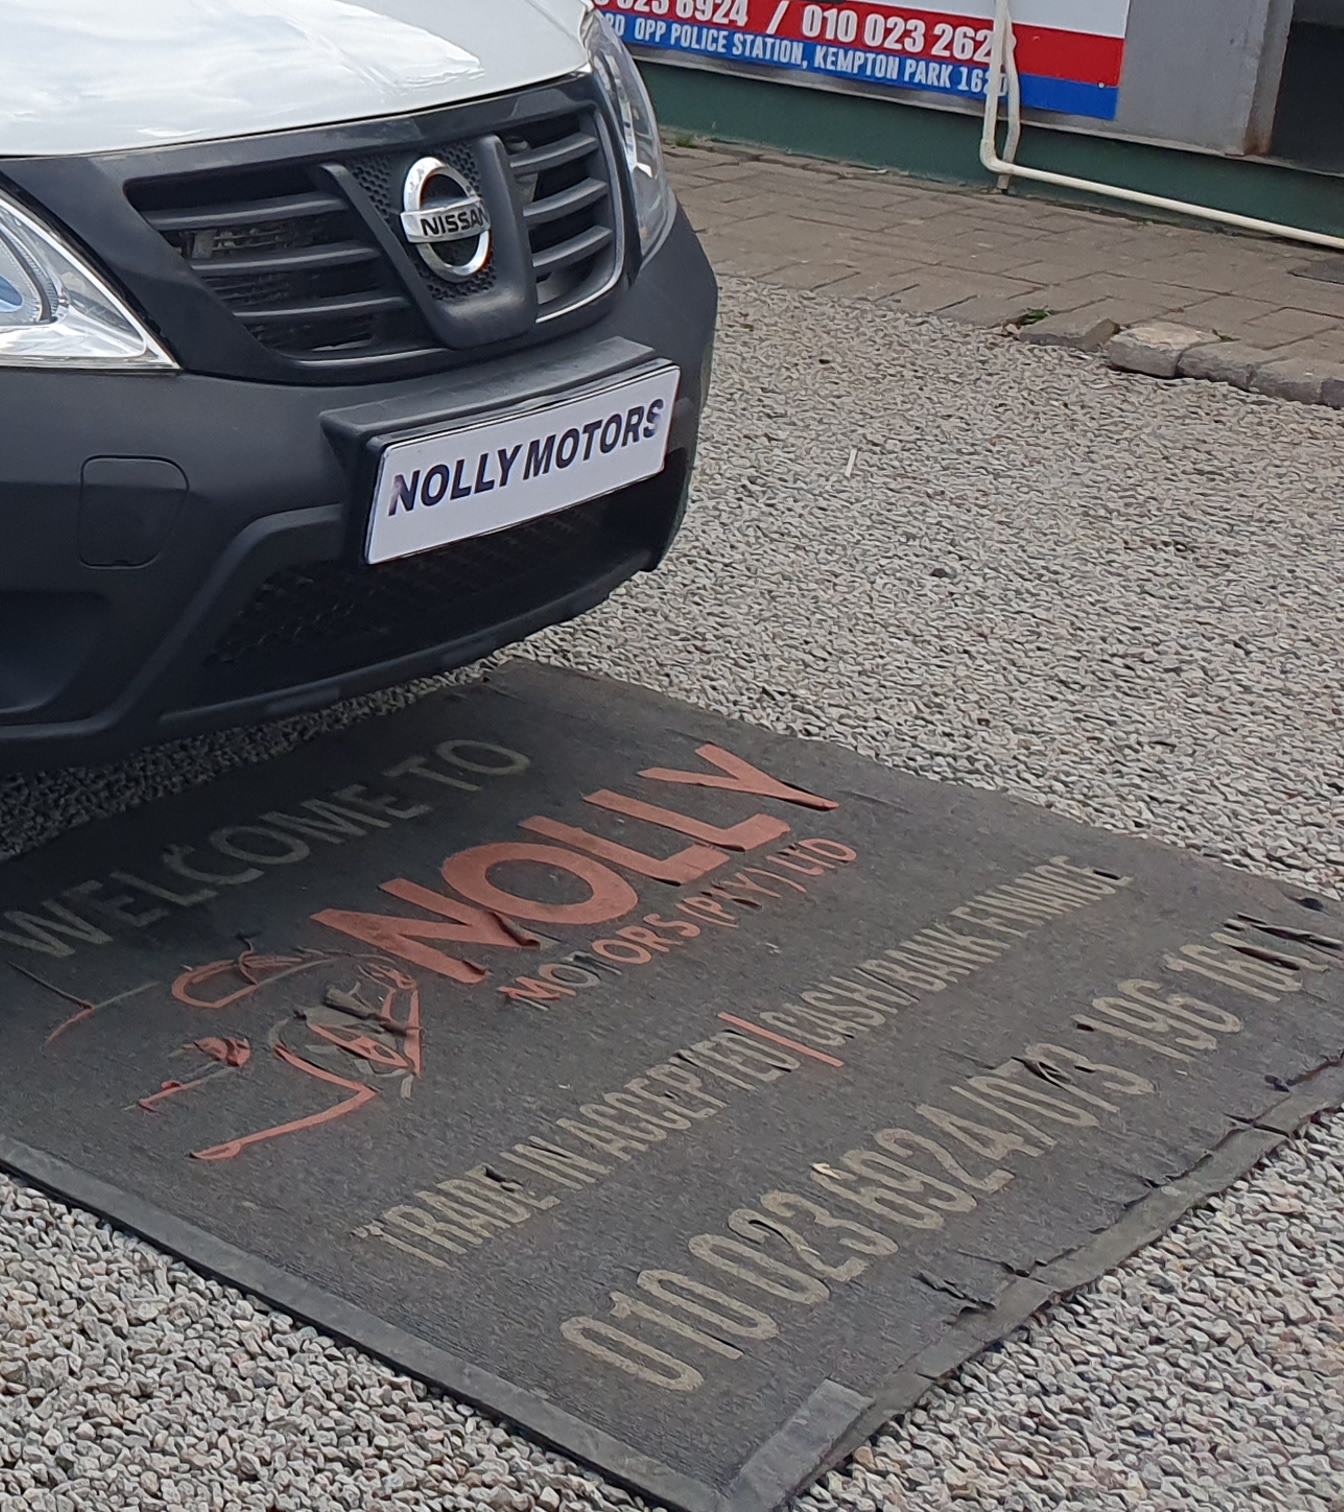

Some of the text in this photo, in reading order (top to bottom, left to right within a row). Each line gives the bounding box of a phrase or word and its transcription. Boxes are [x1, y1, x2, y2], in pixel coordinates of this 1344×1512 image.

[634, 17, 667, 43] OPP
[670, 23, 728, 54] POLICE
[732, 34, 808, 70] STATION,
[815, 45, 900, 82] KEMPTON
[904, 60, 953, 89] PARK
[801, 4, 858, 43] 010
[864, 13, 926, 53] 023
[419, 206, 490, 237] NISSAN
[387, 398, 665, 516] NOLLY MOTORS
[383, 738, 533, 792] TO
[311, 743, 840, 985] NOLLY
[949, 855, 1134, 938] FINANCE
[498, 912, 701, 1011] MOTORS
[766, 838, 858, 877] LTD
[556, 1029, 801, 1161] ACCEPTED
[500, 1135, 615, 1190] IN
[560, 1268, 780, 1392] 010
[687, 1189, 900, 1304] 023
[1071, 978, 1245, 1062] 196
[351, 1163, 562, 1272] TRADE
